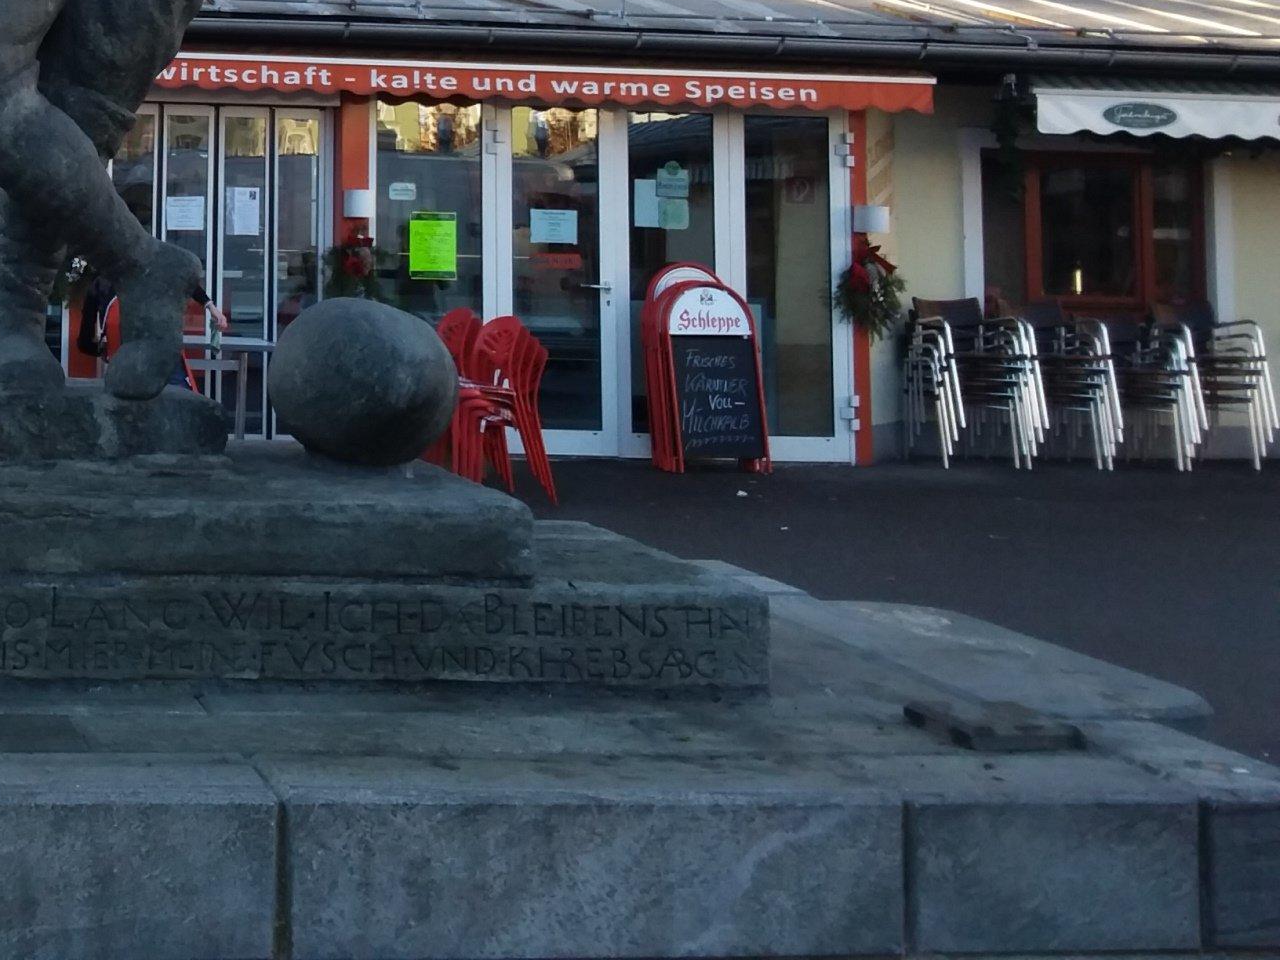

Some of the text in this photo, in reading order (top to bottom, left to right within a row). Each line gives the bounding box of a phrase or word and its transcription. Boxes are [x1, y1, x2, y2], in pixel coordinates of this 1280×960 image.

[370, 68, 458, 90] kalte
[472, 74, 536, 92] und
[550, 80, 670, 97] warme
[685, 80, 817, 103] Speisen
[677, 308, 741, 333] Schleppe
